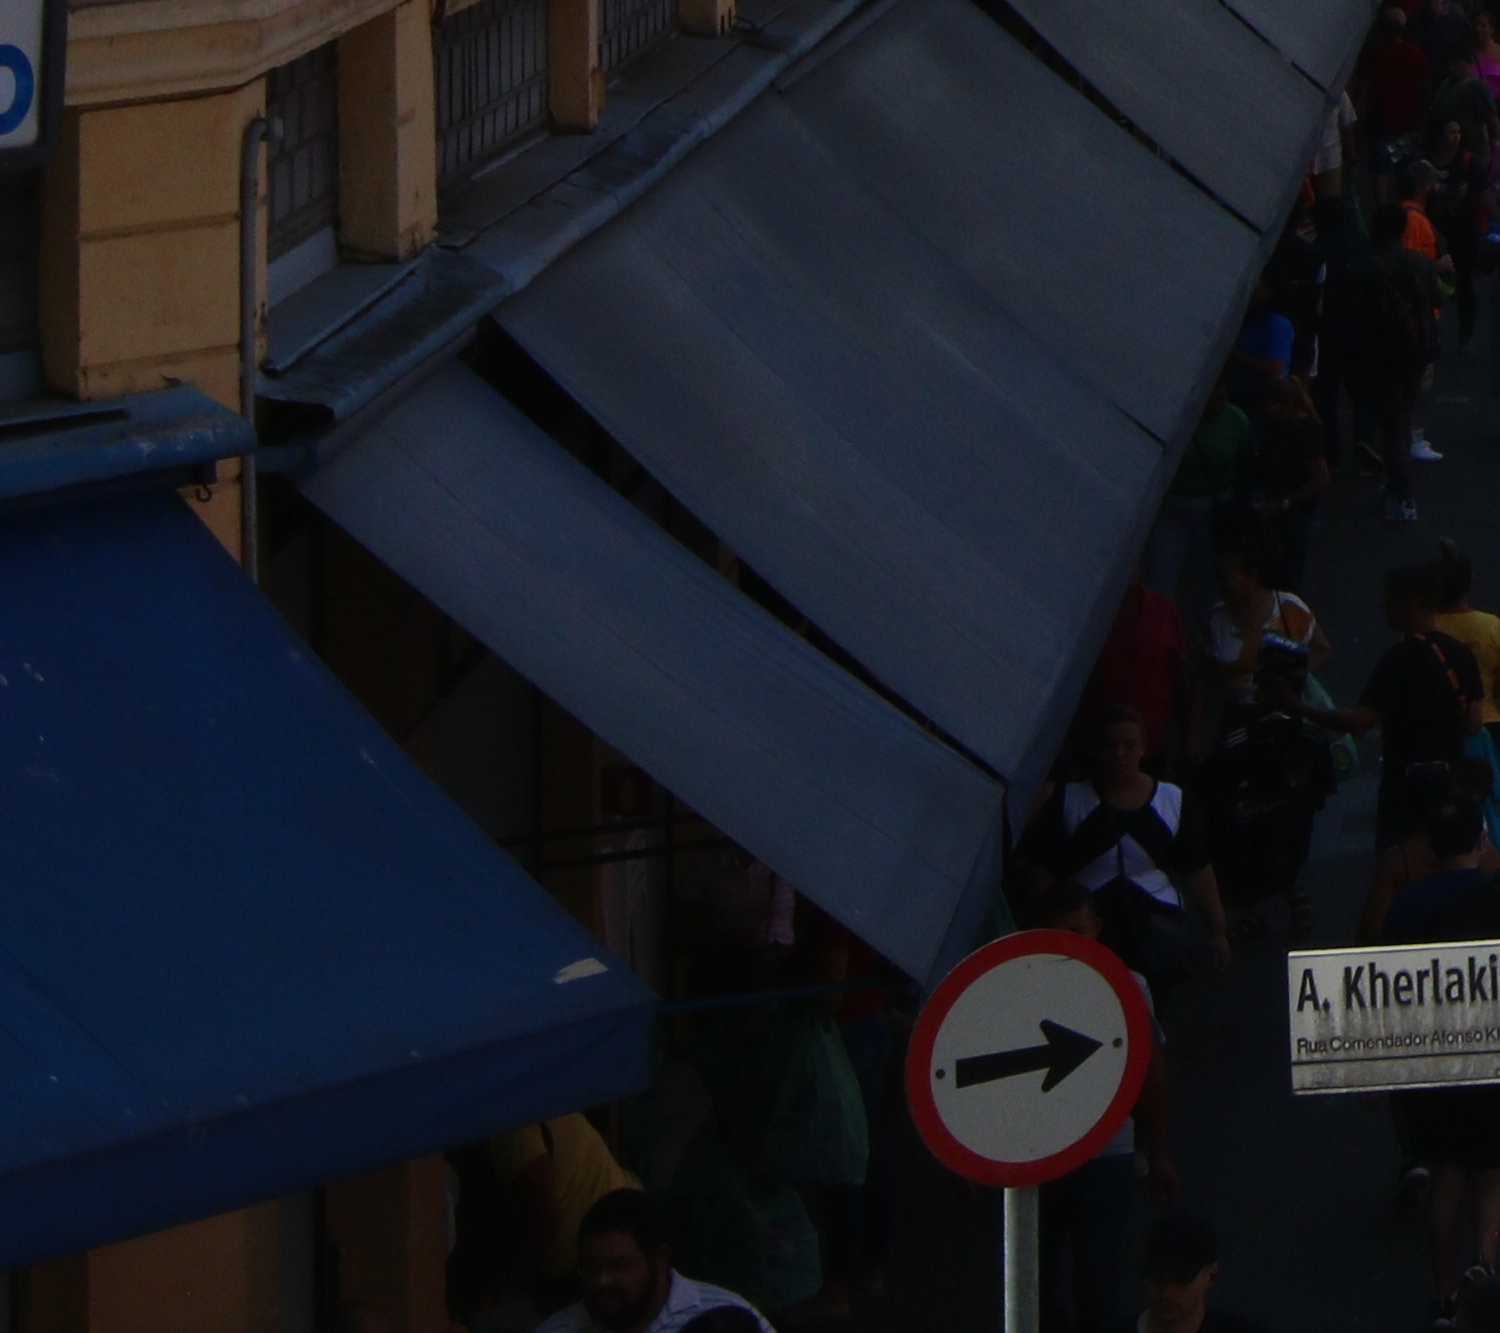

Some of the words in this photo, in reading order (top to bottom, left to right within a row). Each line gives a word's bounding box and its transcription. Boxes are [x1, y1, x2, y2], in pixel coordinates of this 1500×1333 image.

[1296, 967, 1330, 1014] A.
[1296, 1037, 1328, 1055] Rua
[1329, 1030, 1428, 1053] Comendador
